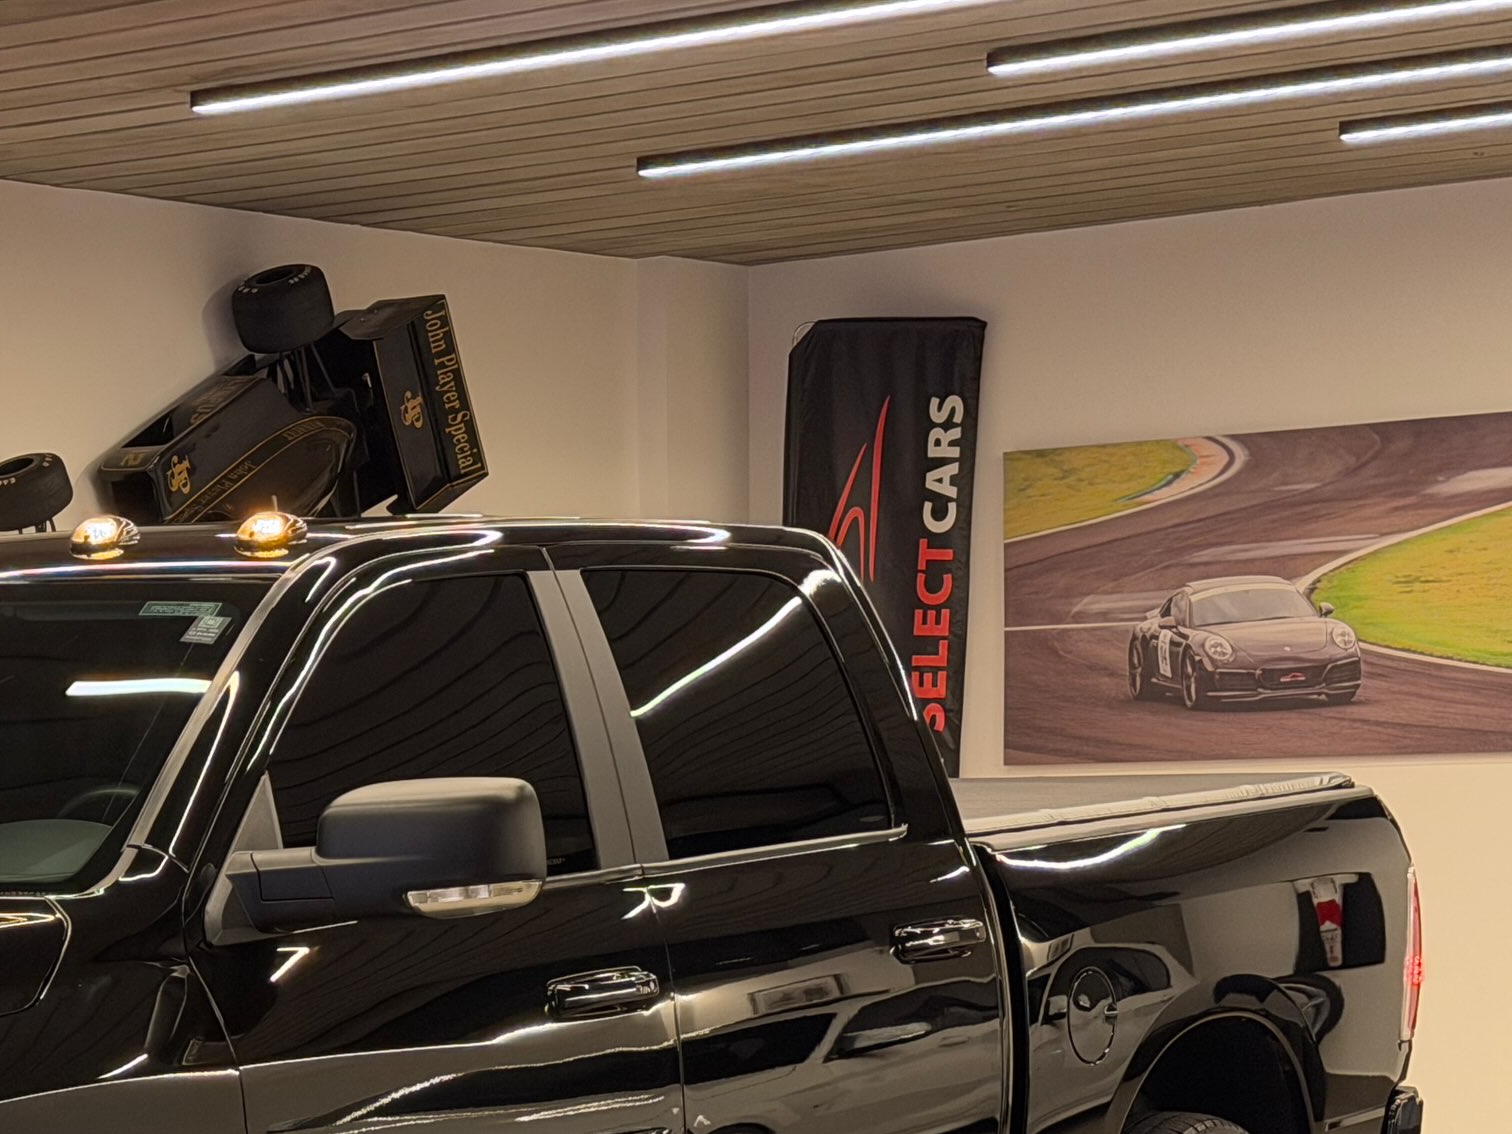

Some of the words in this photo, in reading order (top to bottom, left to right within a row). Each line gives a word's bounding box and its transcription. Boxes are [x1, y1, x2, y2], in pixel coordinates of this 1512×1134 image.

[423, 309, 450, 353] John
[433, 353, 461, 409] Player
[445, 411, 481, 473] Special
[923, 395, 964, 534] CARS
